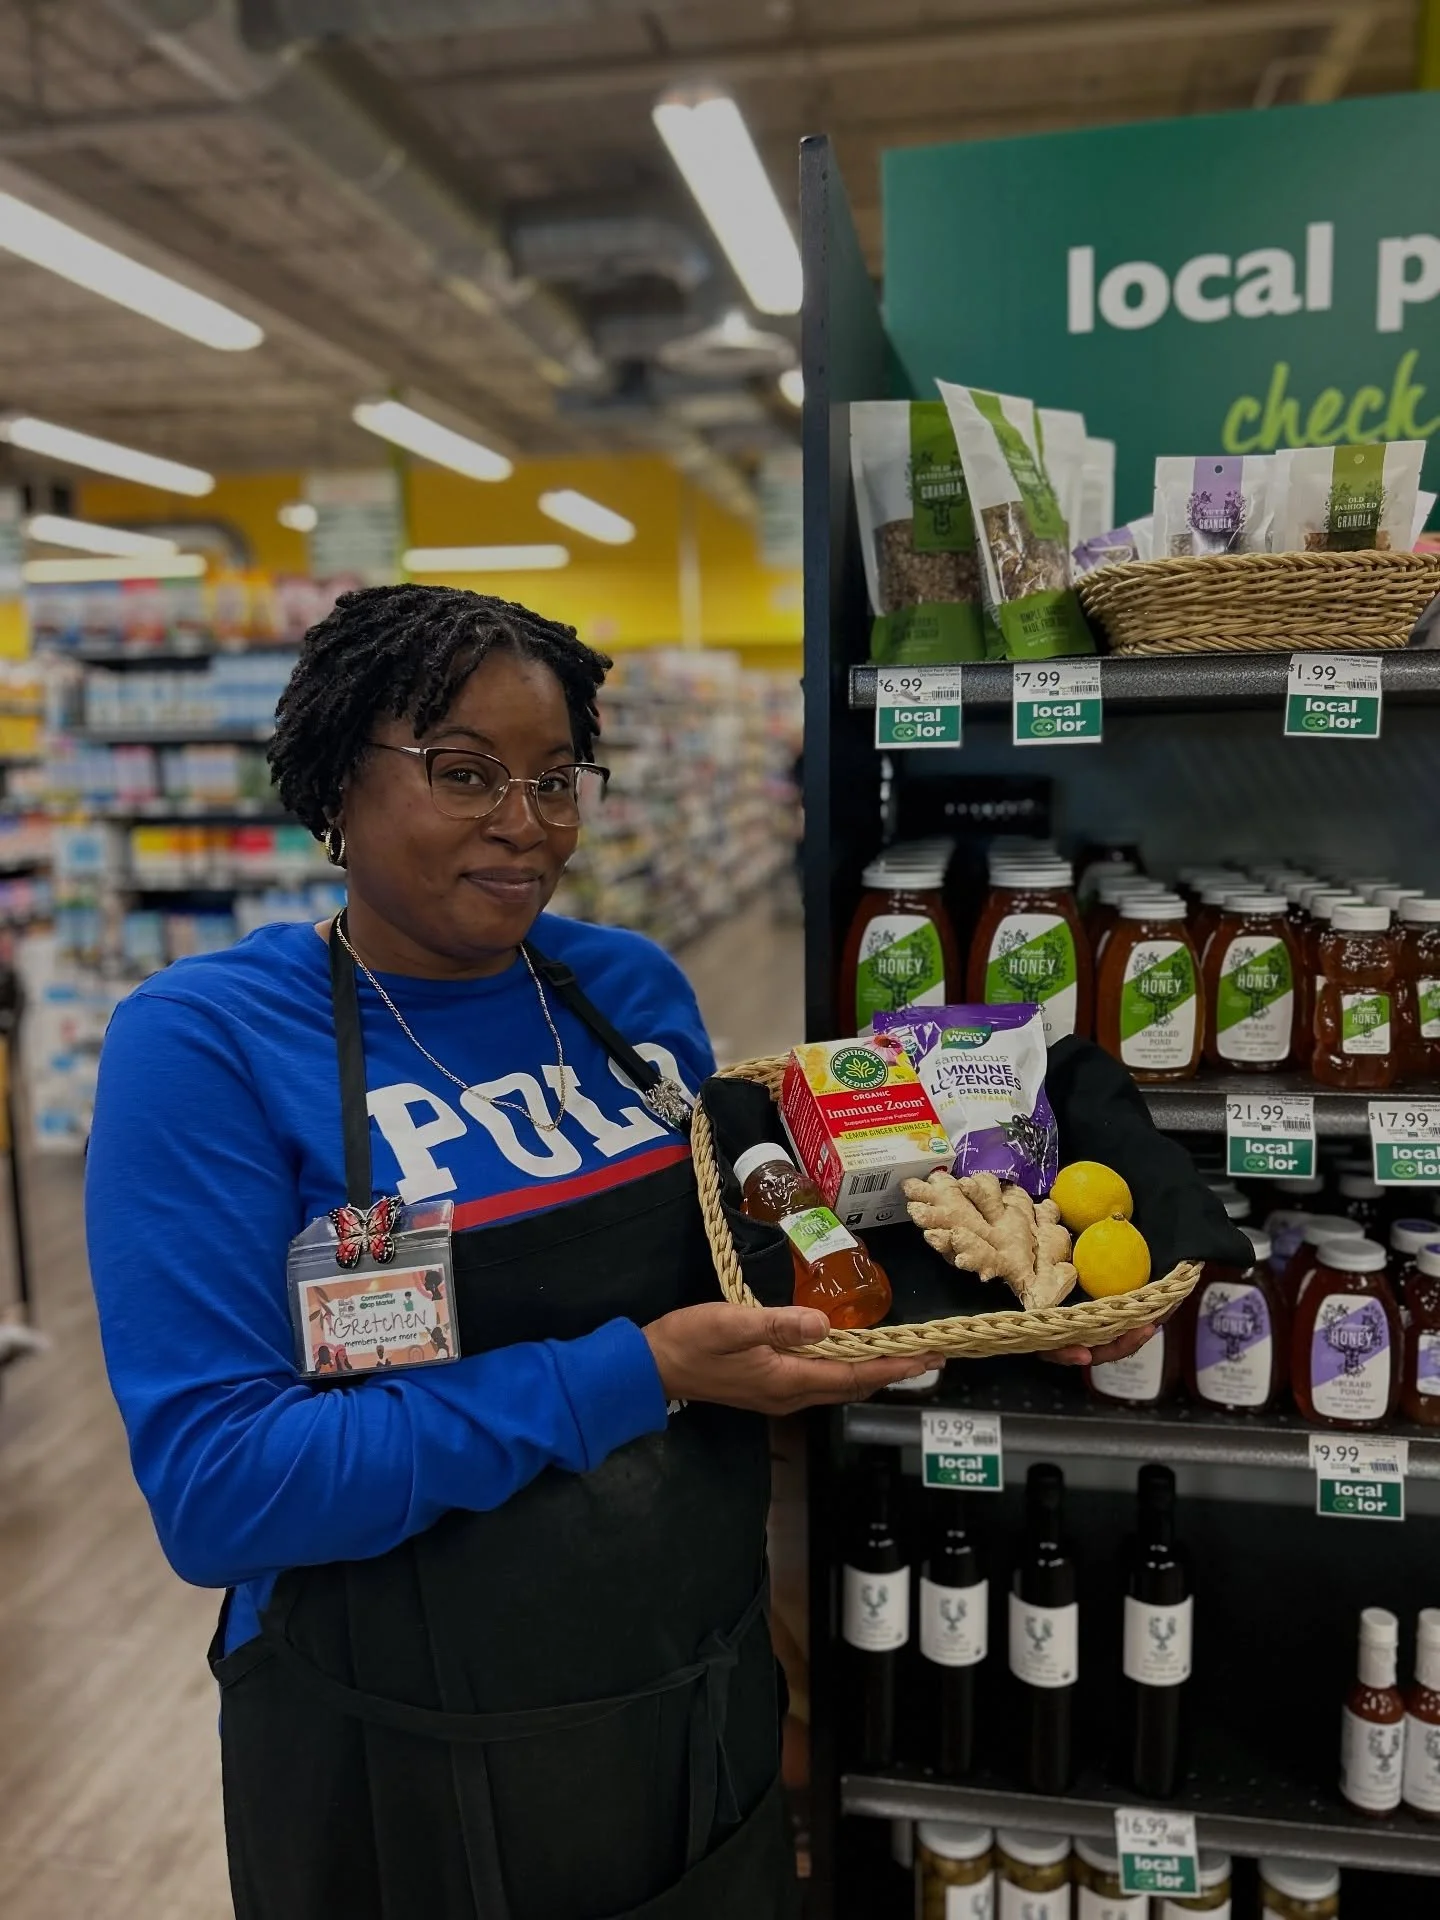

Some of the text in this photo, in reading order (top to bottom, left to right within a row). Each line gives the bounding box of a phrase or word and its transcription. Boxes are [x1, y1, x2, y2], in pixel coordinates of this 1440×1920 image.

[1067, 221, 1334, 335] local
[1221, 349, 1440, 455] check
[921, 481, 962, 500] GRANOLA
[1334, 502, 1378, 511] FASHIONED
[1348, 496, 1365, 504] OLD
[1199, 518, 1232, 530] GRANOLA
[1337, 513, 1371, 528] GRANOLA
[1015, 671, 1060, 688] $7.99
[1288, 663, 1337, 681] $1.99
[878, 678, 923, 692] $6.99
[1032, 702, 1081, 718] local
[1305, 697, 1358, 713] local
[894, 708, 941, 723] local
[877, 958, 923, 975] HONEY
[1009, 959, 1057, 975] HONEY
[1141, 979, 1182, 994] HONEY
[1237, 973, 1279, 989] HONEY
[1351, 1013, 1381, 1025] HONEY
[952, 1029, 987, 1037] Nature's
[1141, 1030, 1179, 1038] ORCHARD
[1149, 1037, 1172, 1046] POND
[834, 1049, 880, 1069] TRADITIONAL
[935, 1052, 1008, 1067] sambucus
[840, 1070, 885, 1088] MEDICINALS
[936, 1064, 1013, 1080] IMMUNE
[930, 1075, 1022, 1095] LOZENGES
[947, 1088, 1013, 1098] EDERBERRY
[852, 1090, 891, 1101] ORGANIC
[826, 1103, 884, 1119] Immune
[1226, 1103, 1284, 1121] $21.99
[366, 1042, 696, 1206] POLO
[844, 1118, 871, 1127] Supports
[1369, 1112, 1429, 1128] $17.99
[845, 1122, 932, 1140] LEMON GINGER ECHINACEA
[1245, 1139, 1294, 1155] local
[1392, 1145, 1440, 1160] local
[799, 1220, 831, 1237] HONEY
[360, 1293, 393, 1302] Community
[1213, 1317, 1254, 1333] HONEY
[344, 1337, 378, 1347] members
[399, 1332, 417, 1340] more
[1330, 1331, 1374, 1346] HONEY
[922, 1419, 974, 1436] $19.99
[1315, 1444, 1360, 1462] $9.99
[938, 1455, 983, 1470] local
[1334, 1481, 1383, 1498] local
[1134, 1855, 1179, 1873] local
